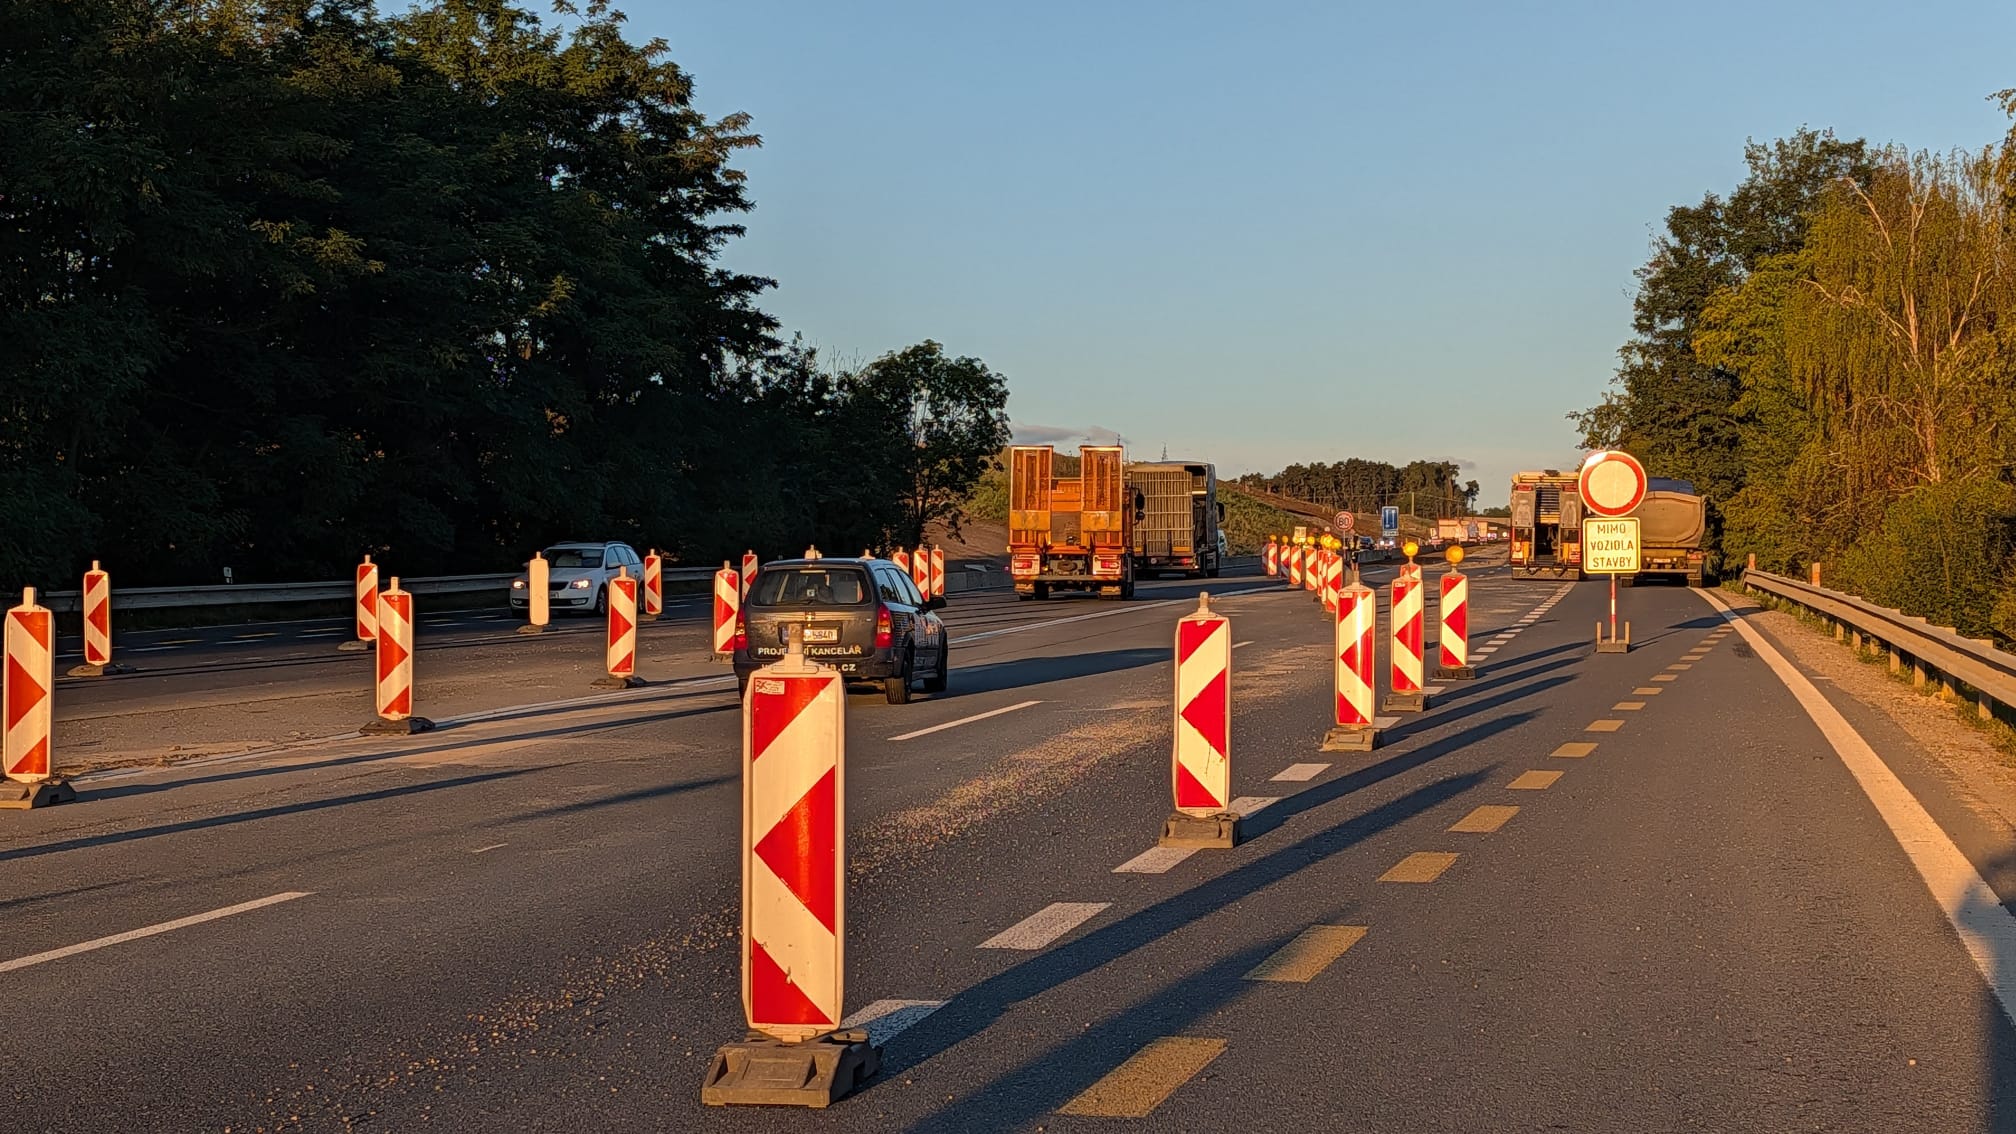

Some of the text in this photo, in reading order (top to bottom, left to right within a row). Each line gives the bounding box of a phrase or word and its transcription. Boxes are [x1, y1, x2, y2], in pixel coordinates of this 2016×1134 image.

[1597, 523, 1626, 534] MIMO
[1590, 540, 1634, 551] VOZIDLA
[1592, 556, 1632, 568] STAVBY
